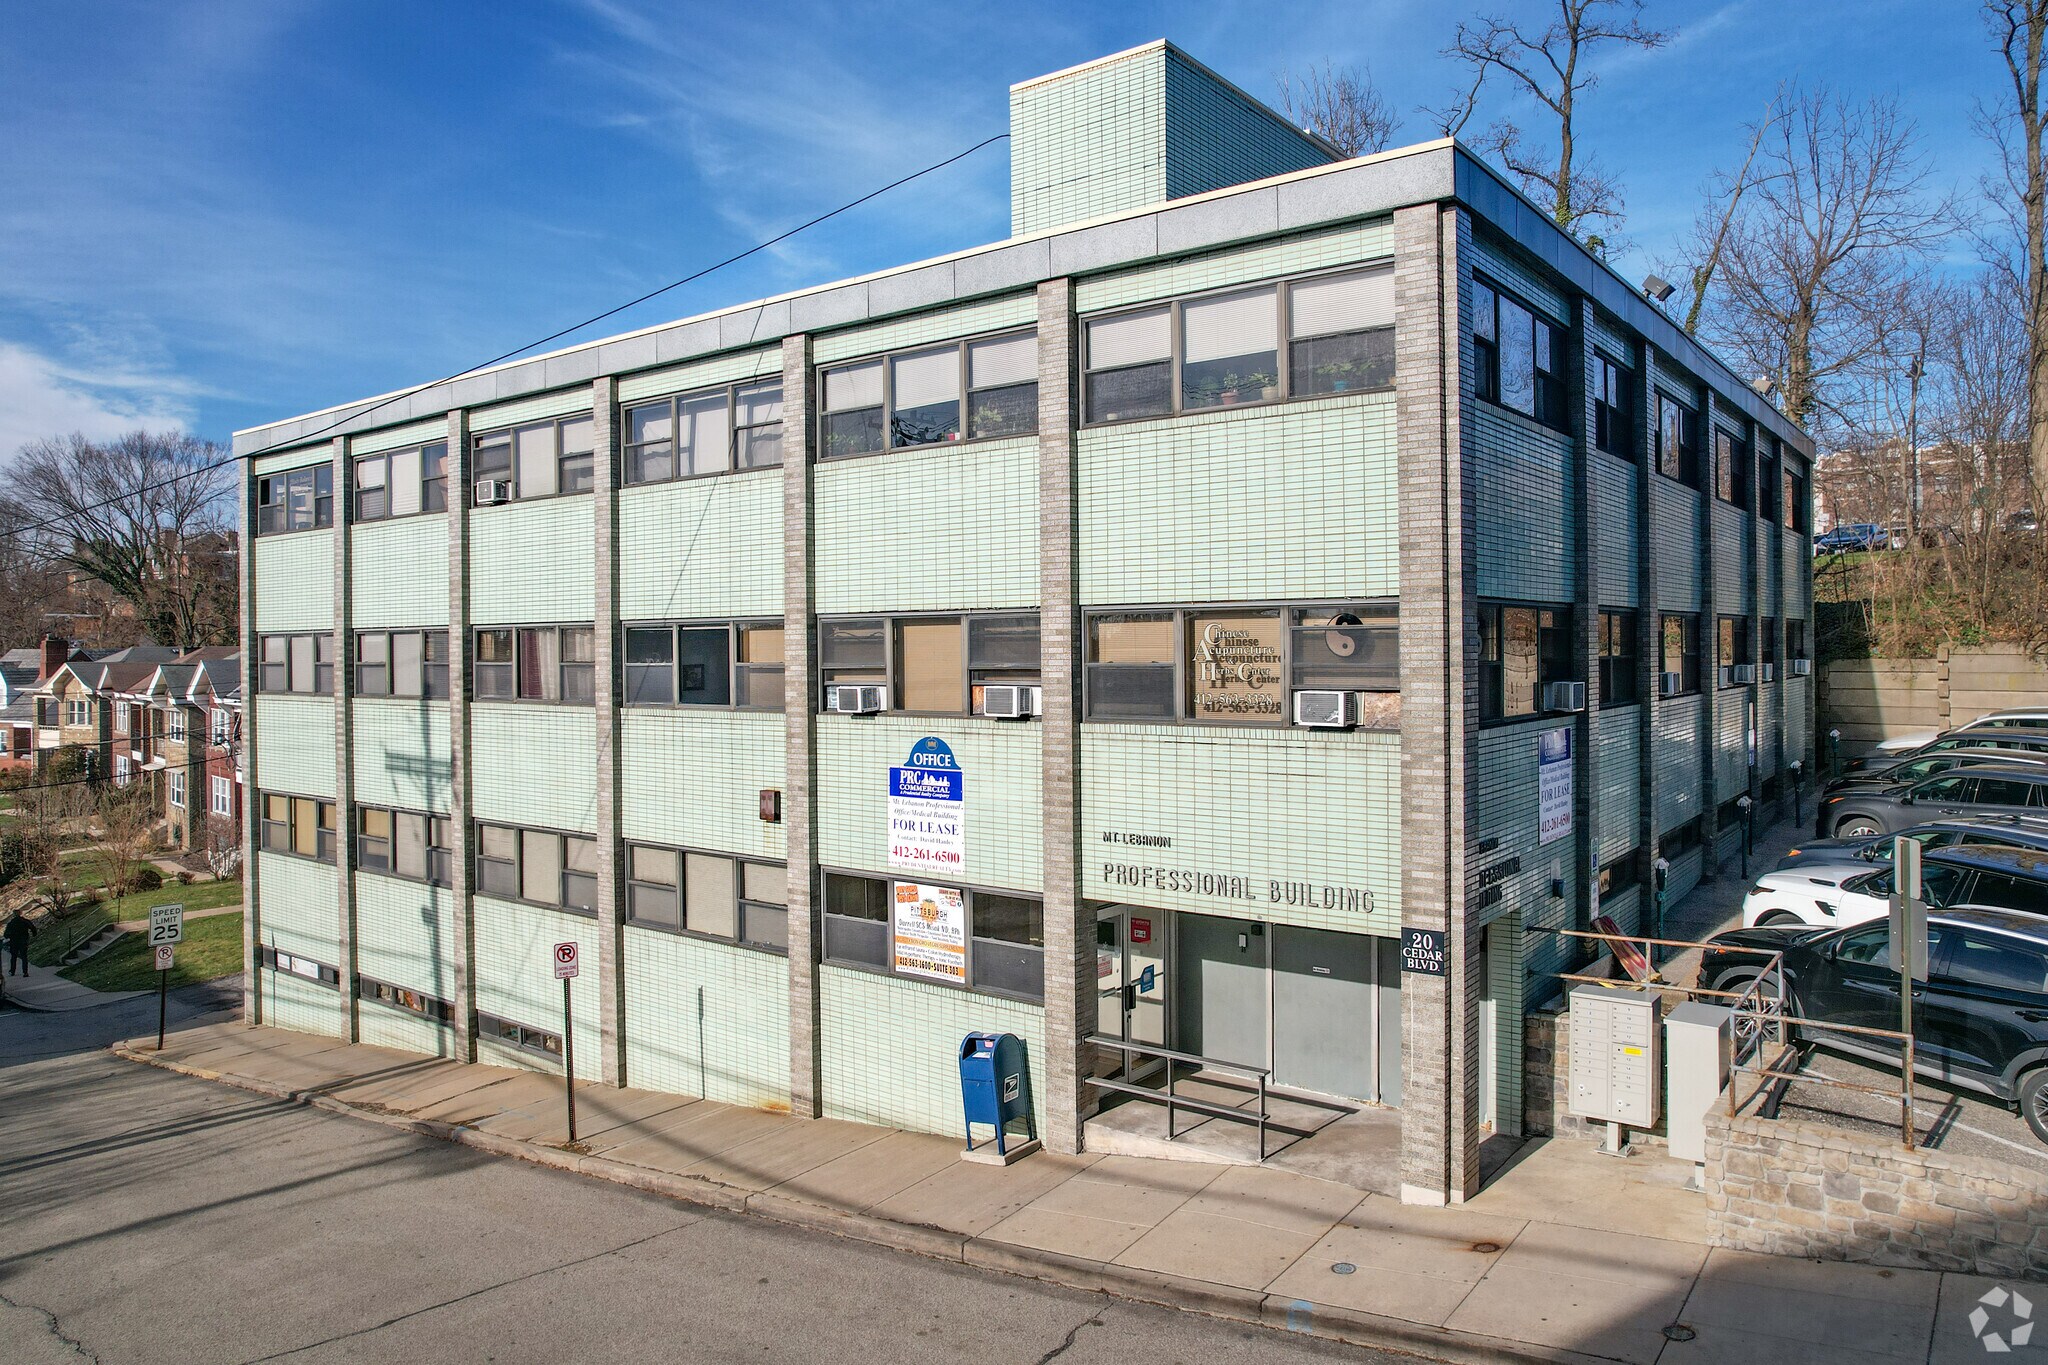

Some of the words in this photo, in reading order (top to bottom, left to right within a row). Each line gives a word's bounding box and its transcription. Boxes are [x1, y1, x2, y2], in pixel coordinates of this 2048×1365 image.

[1204, 623, 1249, 645] Chinese
[1192, 640, 1274, 661] Acupuncture
[1200, 662, 1234, 680] Herbs
[1238, 663, 1271, 681] Center
[1194, 693, 1273, 705] 412-563-3328
[914, 753, 951, 766] OFFICE
[900, 770, 921, 784] PRC
[899, 784, 950, 793] COMMERCIAL
[1541, 788, 1553, 803] FOR
[1554, 783, 1570, 799] LEASE
[926, 802, 961, 810] Professional
[934, 811, 958, 820] Building
[894, 818, 916, 831] FOR
[920, 821, 959, 836] LEASE
[1123, 833, 1171, 848] LEBANON
[892, 845, 960, 864] 412-261-6500
[1103, 862, 1256, 900] PROFESSIONAL
[1270, 879, 1374, 913] BUILDING
[153, 908, 181, 917] SPEED
[911, 906, 947, 918] PITTSBURGH
[156, 916, 177, 925] LIMIT
[154, 924, 178, 940] 25
[1412, 932, 1433, 950] 20
[1403, 947, 1443, 962] CEDAR
[1407, 958, 1440, 971] BLVD.
